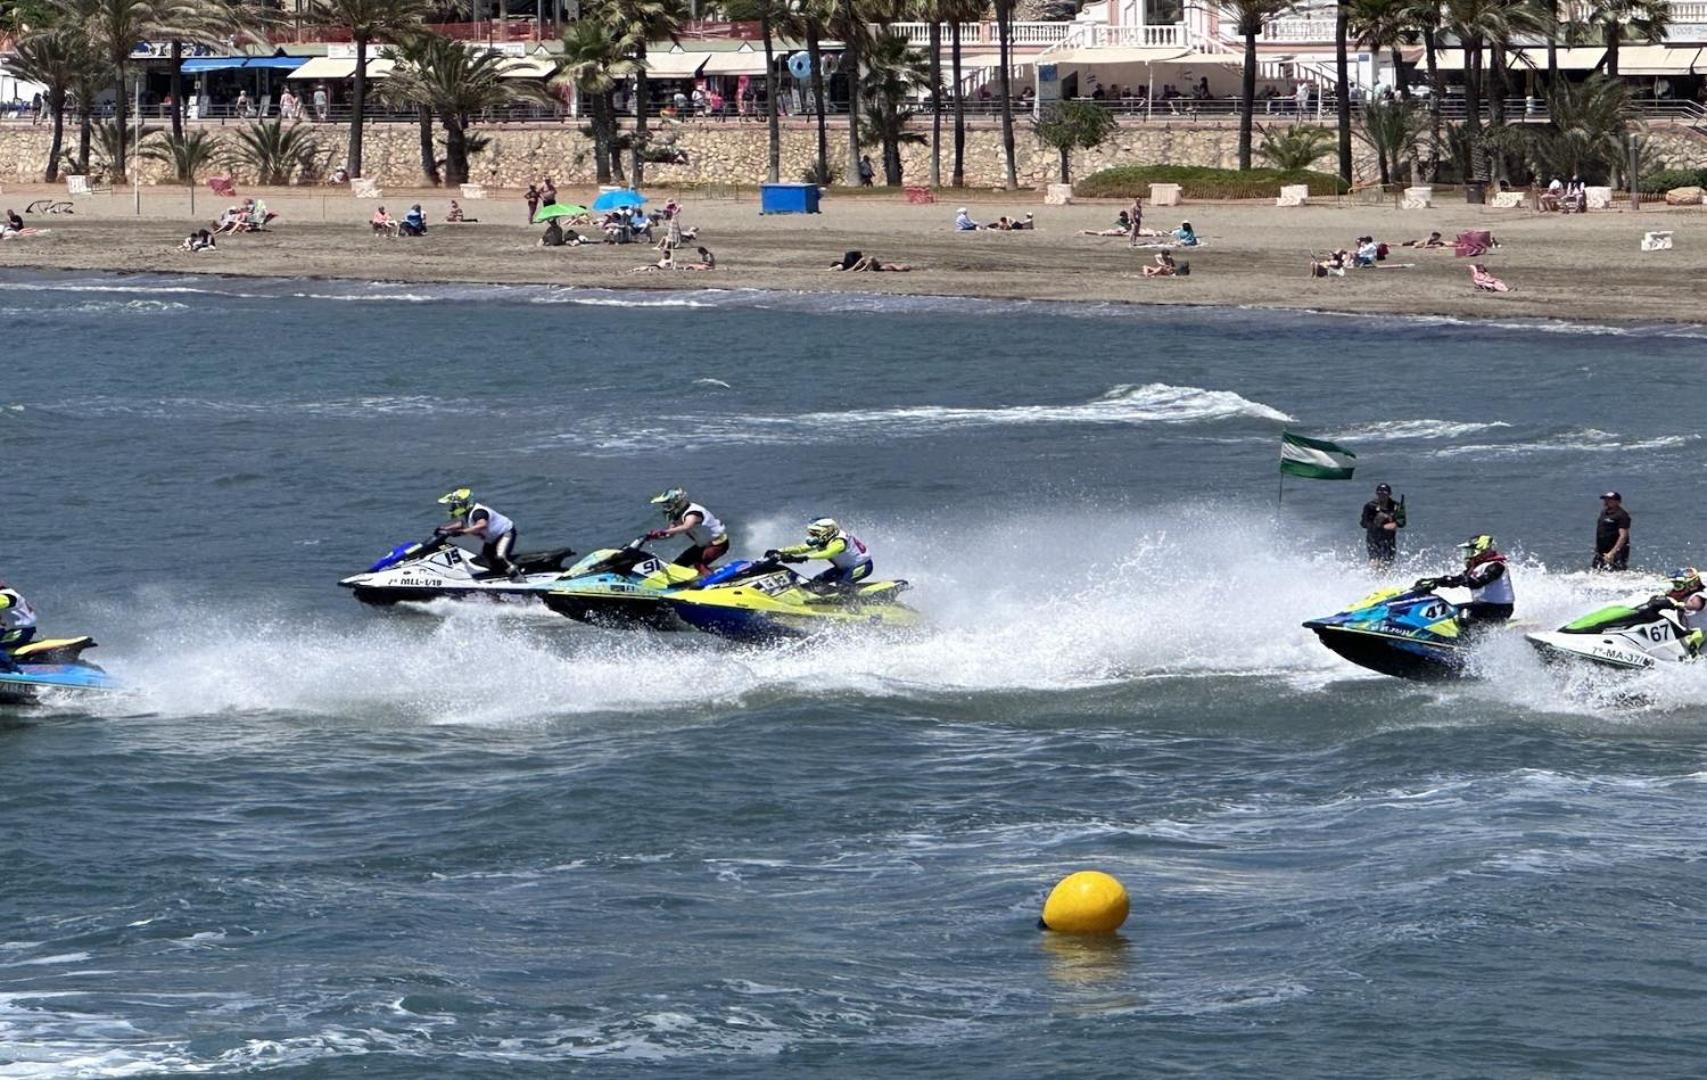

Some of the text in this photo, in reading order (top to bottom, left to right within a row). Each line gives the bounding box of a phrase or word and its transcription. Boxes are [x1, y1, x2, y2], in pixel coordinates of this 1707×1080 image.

[643, 559, 660, 575] 91
[1425, 602, 1447, 619] 47
[1650, 623, 1669, 643] 67
